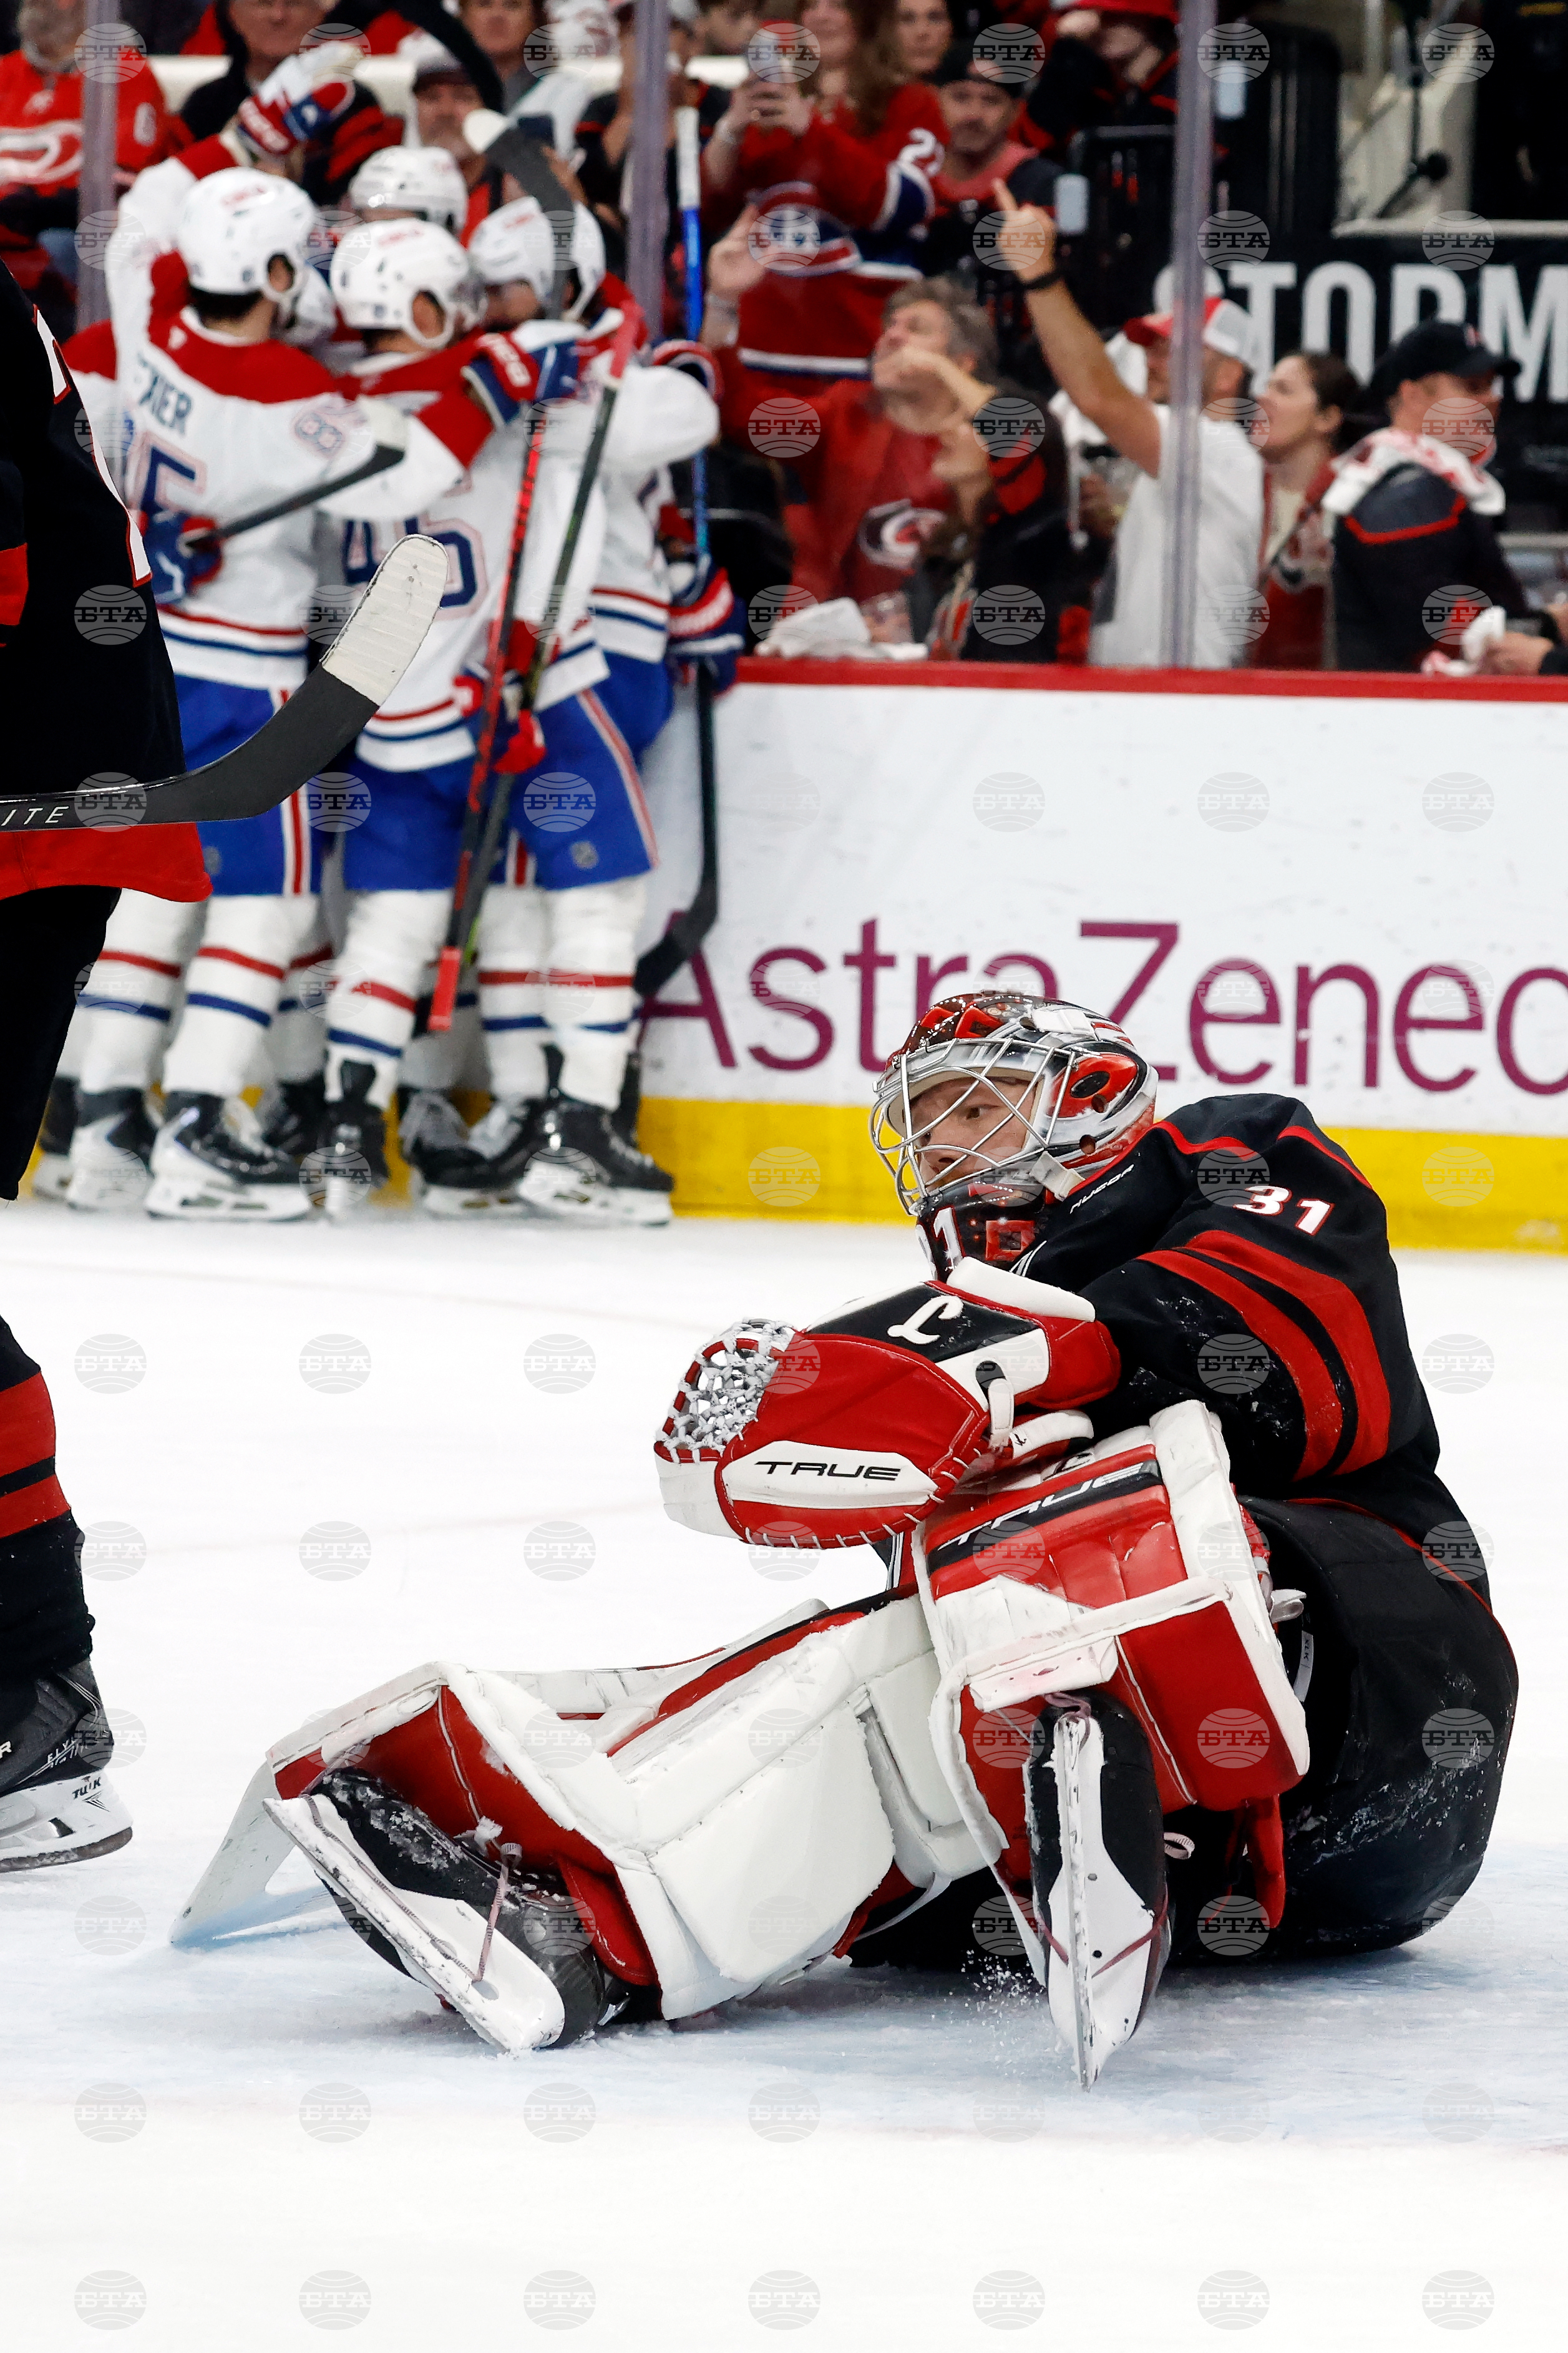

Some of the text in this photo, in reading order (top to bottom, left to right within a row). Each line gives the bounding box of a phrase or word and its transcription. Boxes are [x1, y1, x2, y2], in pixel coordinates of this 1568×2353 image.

[1, 806, 69, 826] ITE
[1232, 1185, 1336, 1238] 31
[887, 1294, 965, 1345] L
[754, 1460, 902, 1482] TRUE
[937, 1461, 1146, 1552] TRUE
